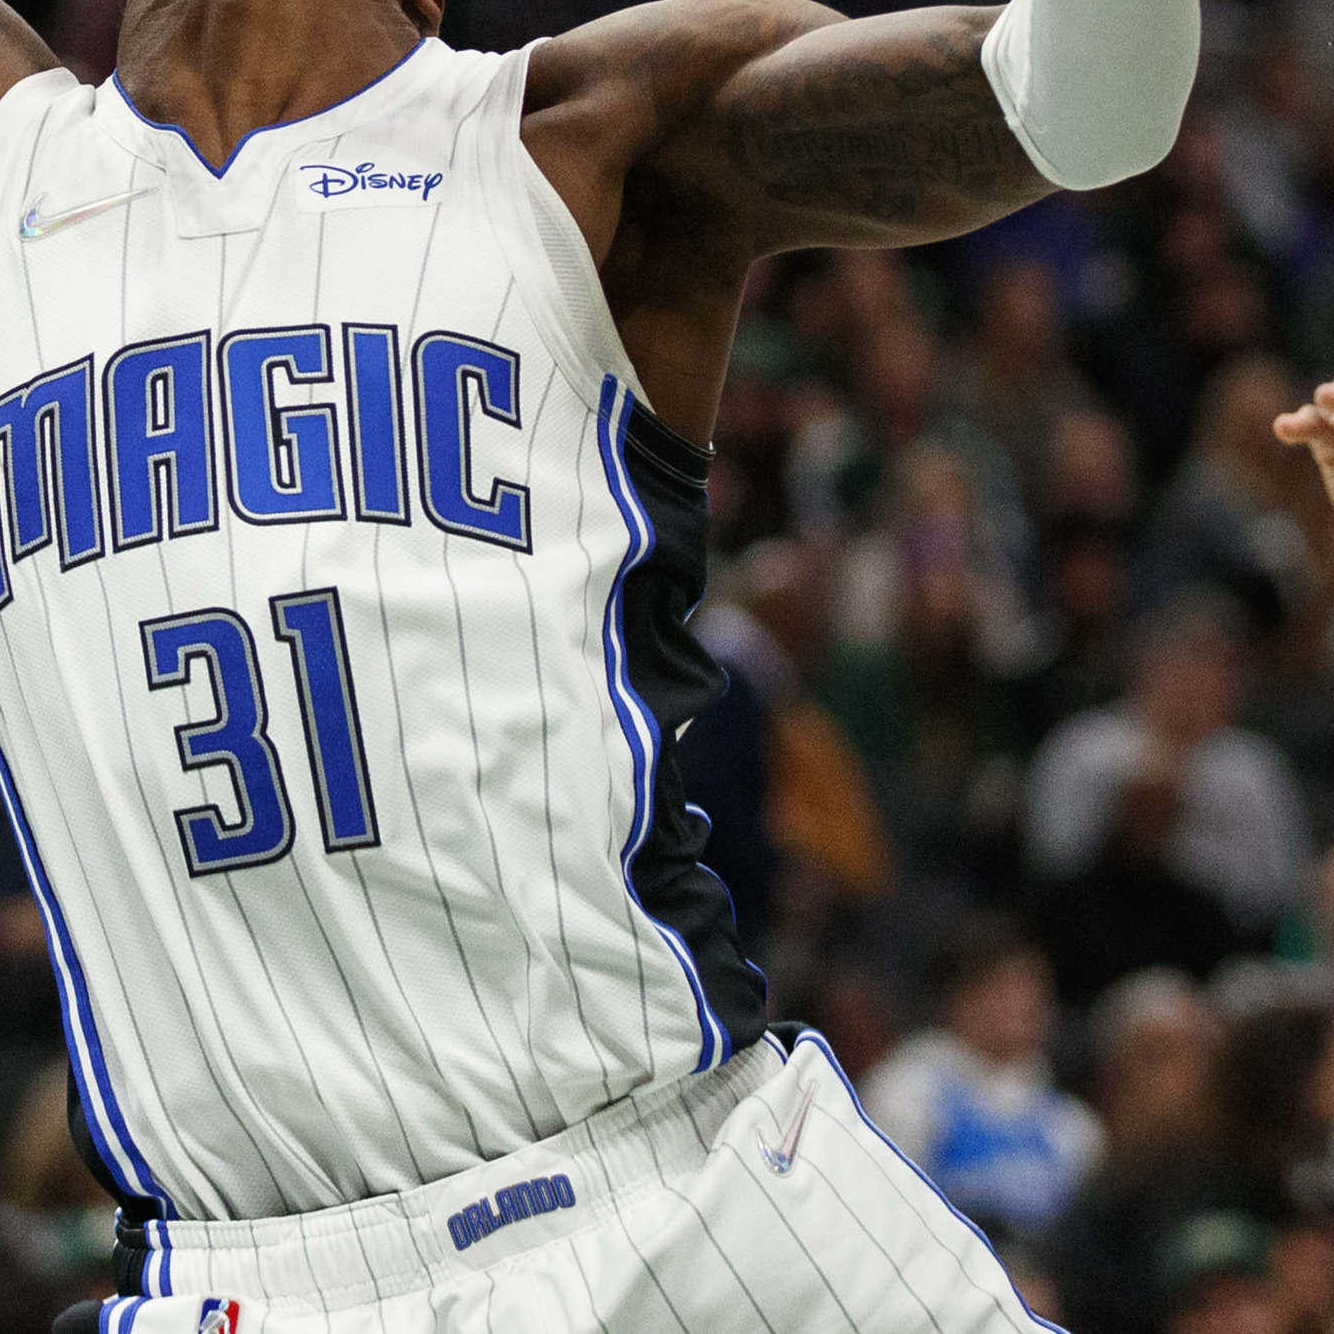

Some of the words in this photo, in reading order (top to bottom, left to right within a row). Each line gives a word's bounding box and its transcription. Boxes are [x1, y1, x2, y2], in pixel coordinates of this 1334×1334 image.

[300, 162, 443, 201] Disney
[139, 587, 380, 878] 31
[447, 1174, 576, 1251] ORLANDO
